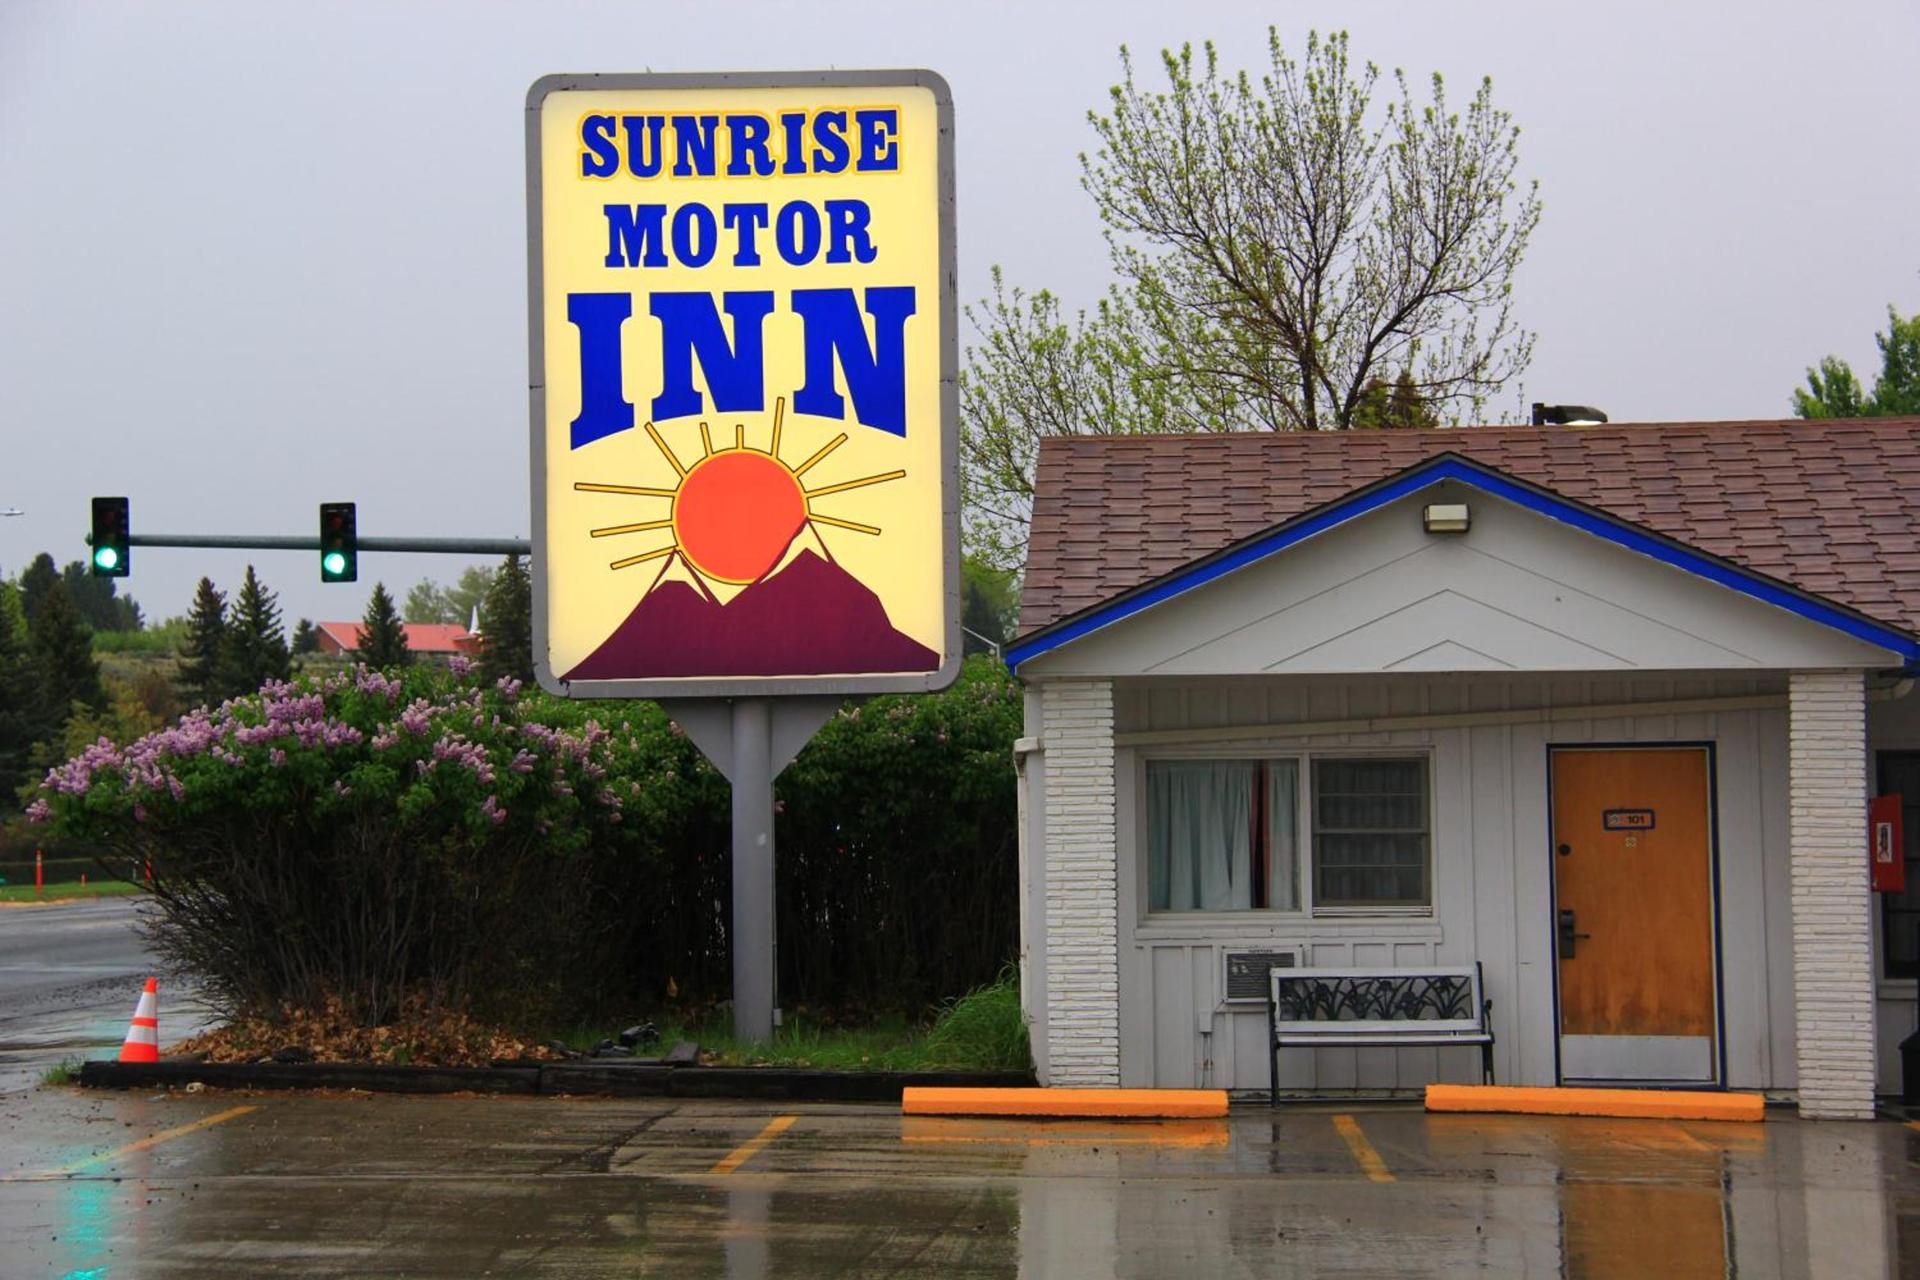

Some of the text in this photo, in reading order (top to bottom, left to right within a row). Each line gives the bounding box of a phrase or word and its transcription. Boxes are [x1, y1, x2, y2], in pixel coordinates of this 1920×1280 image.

[582, 109, 898, 177] SUNRISE
[604, 199, 877, 268] MOTOR
[567, 286, 916, 451] INN
[1628, 815, 1645, 825] 101
